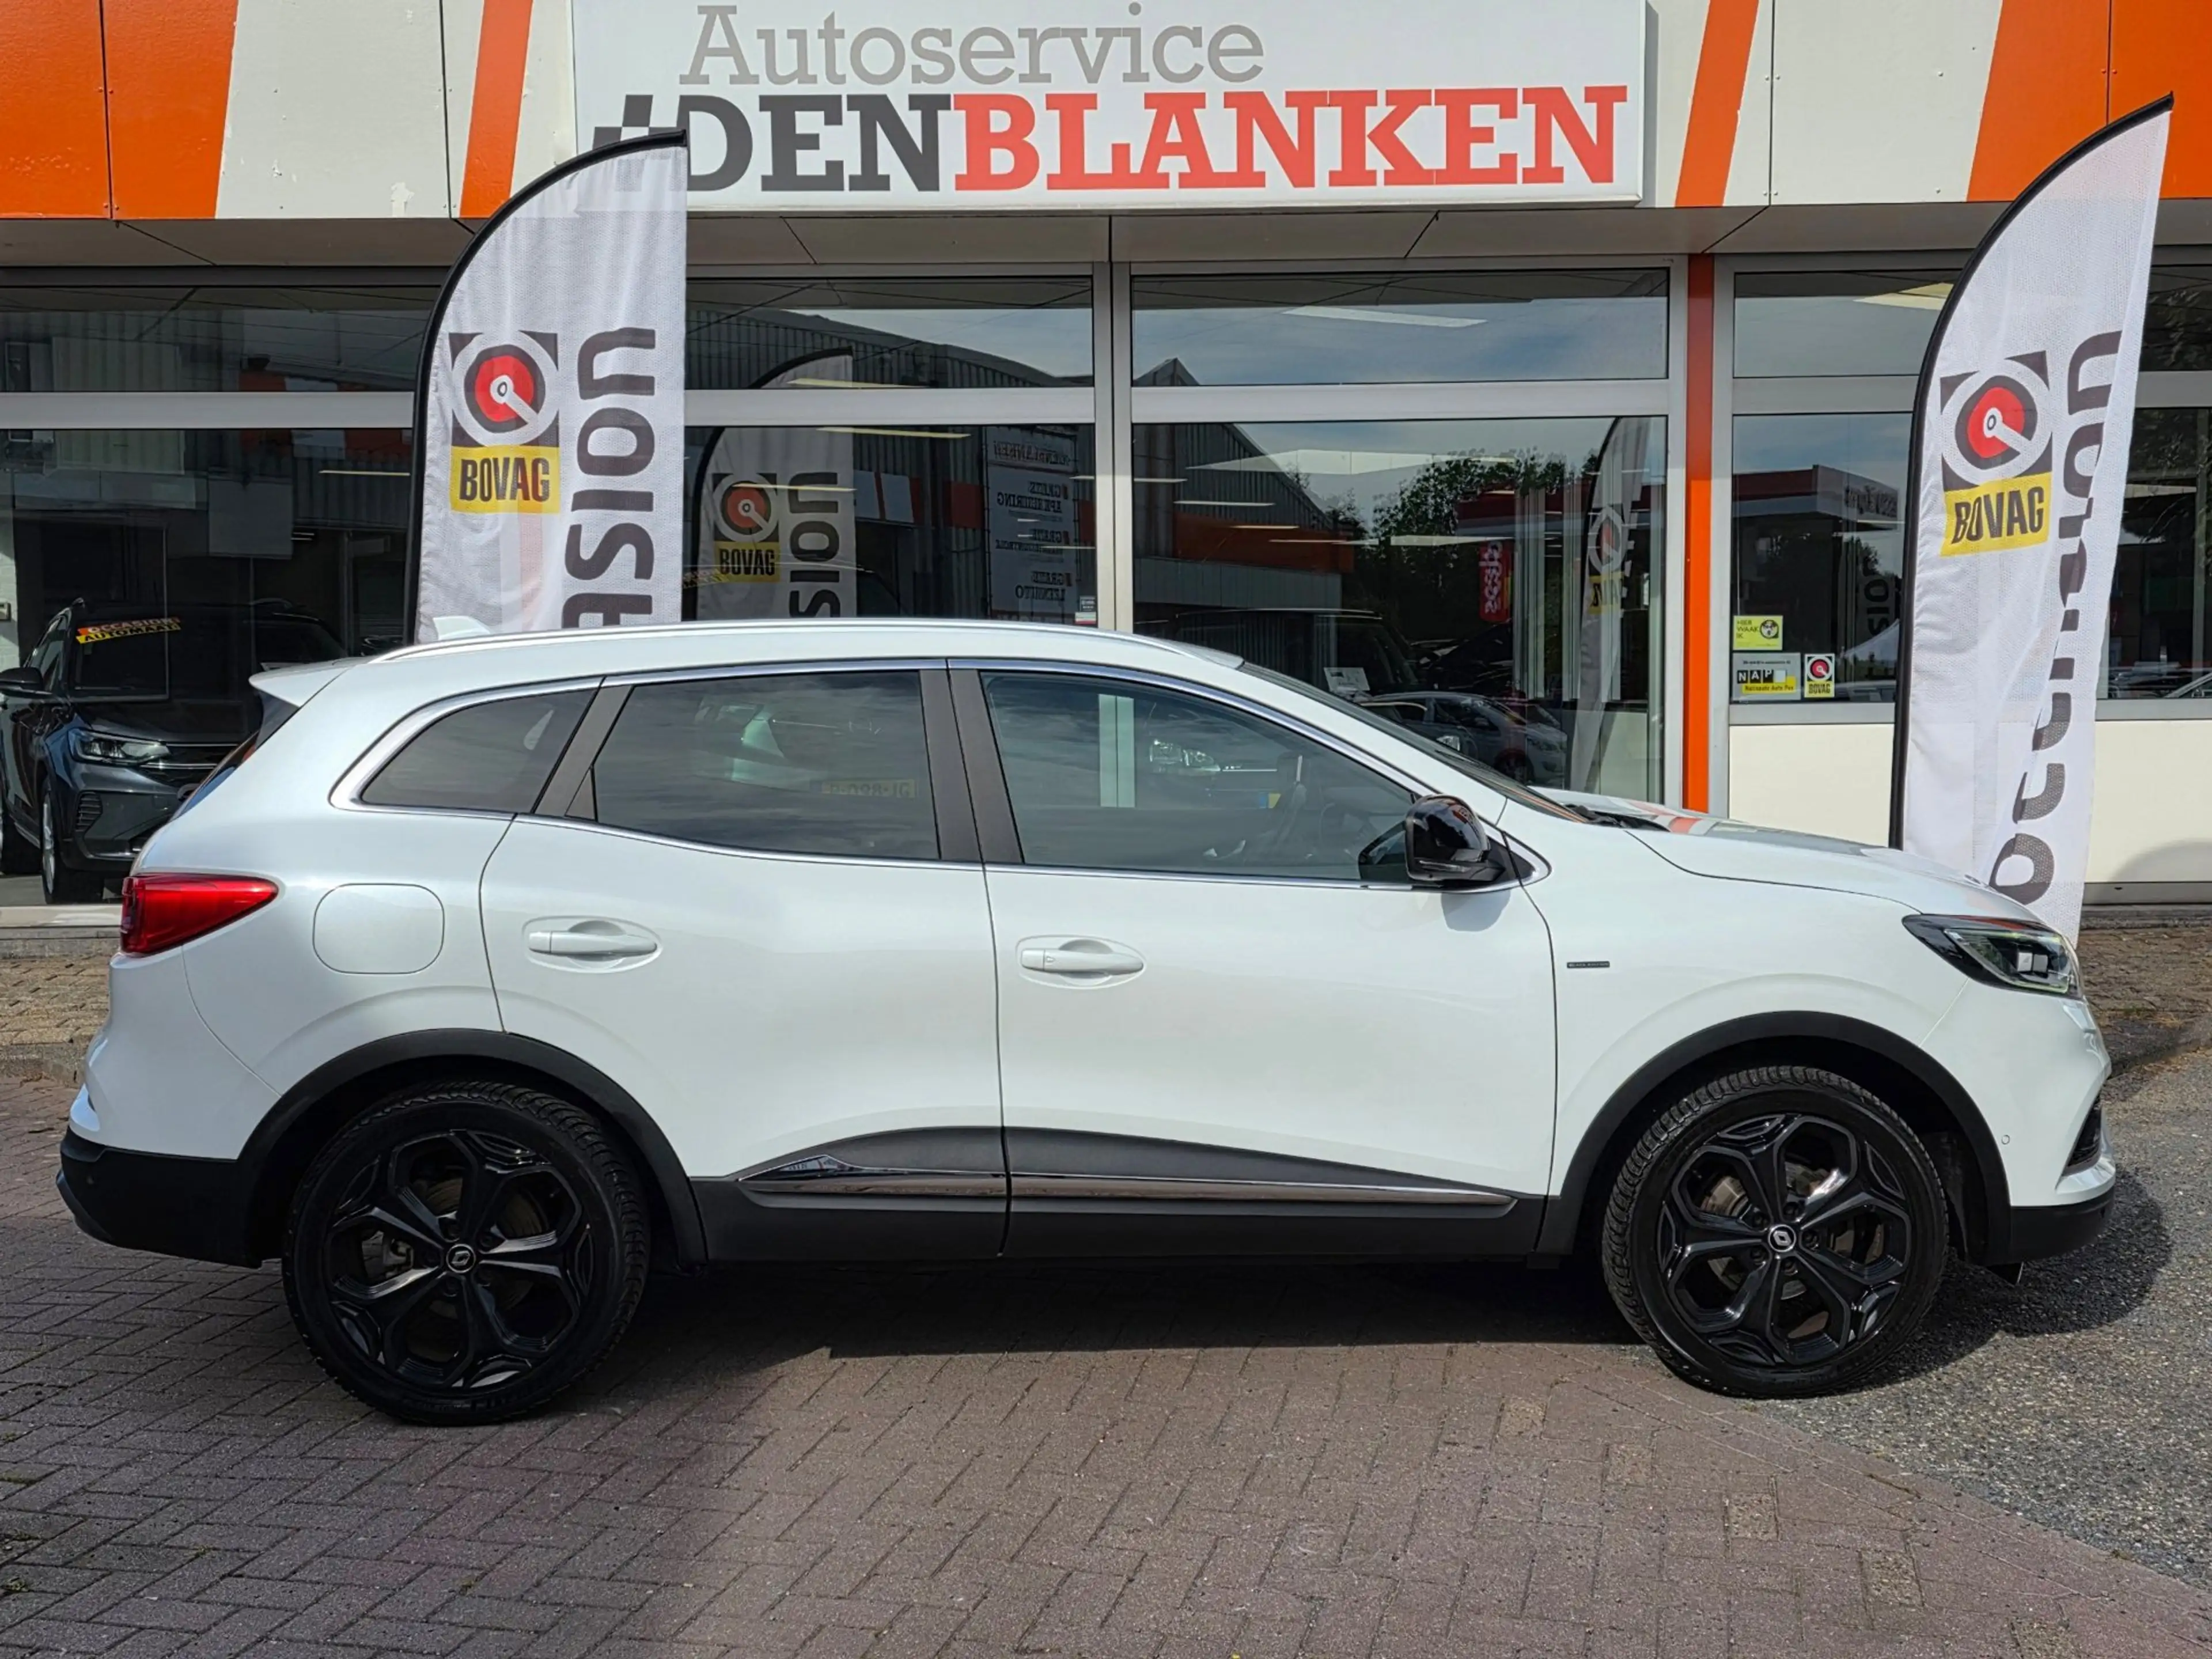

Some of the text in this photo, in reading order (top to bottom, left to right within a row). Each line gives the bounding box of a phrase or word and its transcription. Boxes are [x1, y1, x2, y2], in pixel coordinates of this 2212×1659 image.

[679, 2, 1264, 85] Autoservice
[459, 457, 550, 503] BOVAG
[1951, 486, 2044, 544] BOVAG
[719, 548, 776, 576] BOVAG
[1738, 669, 1772, 681] NAP
